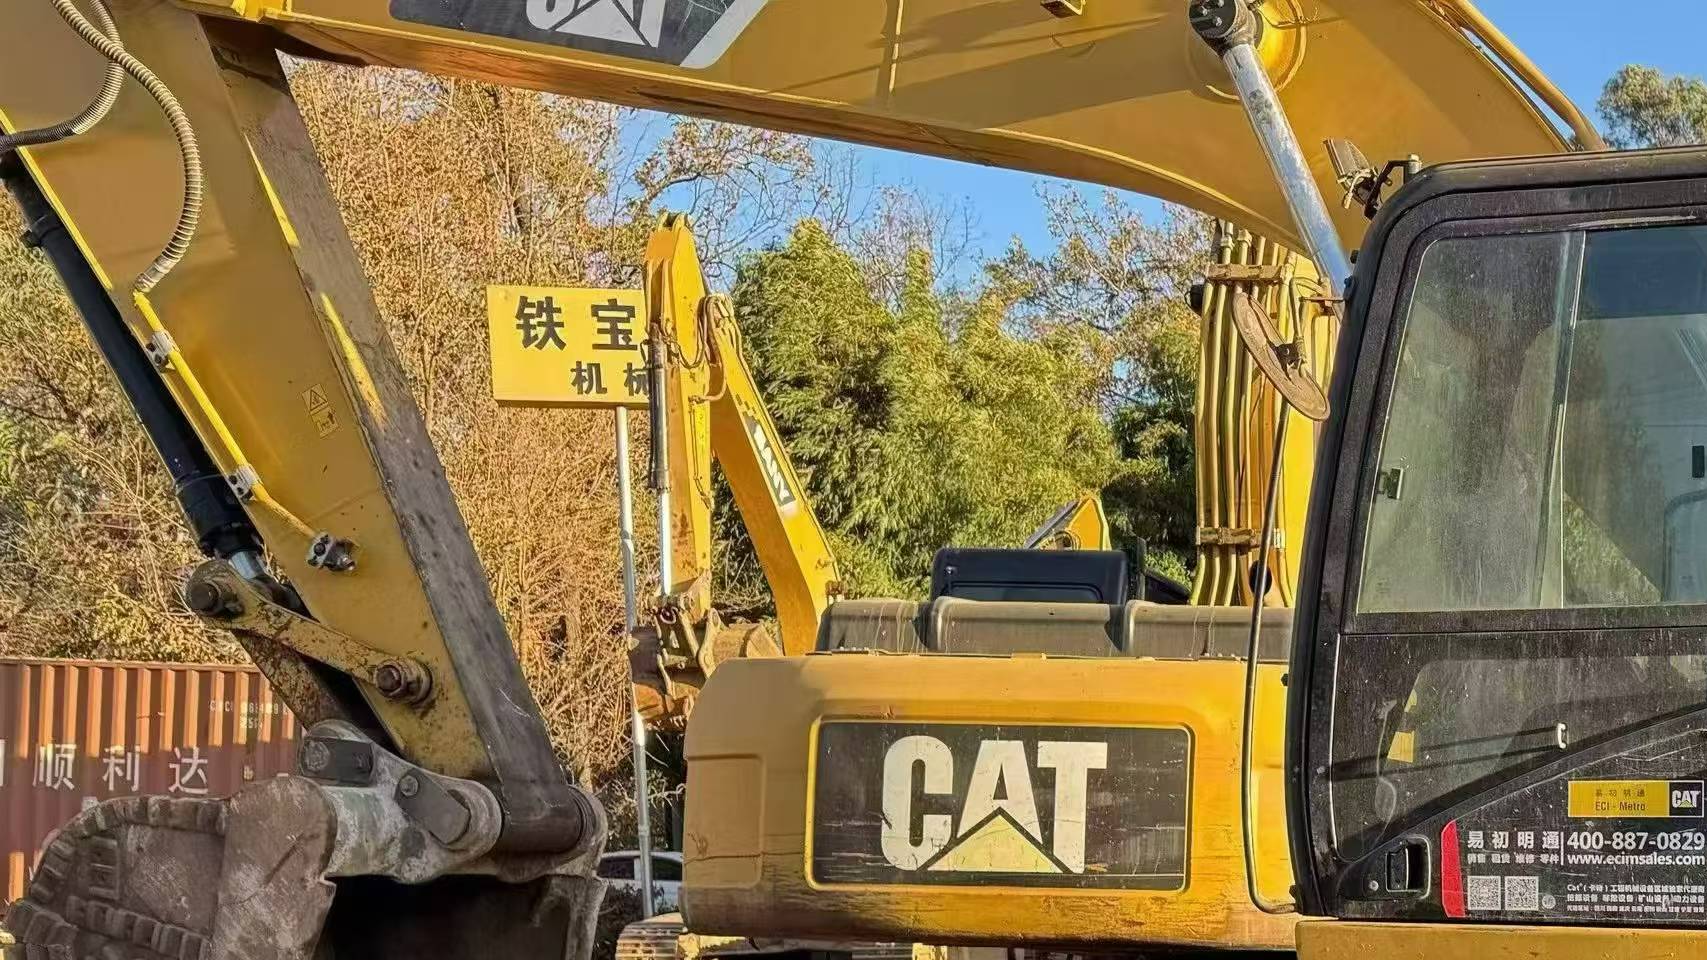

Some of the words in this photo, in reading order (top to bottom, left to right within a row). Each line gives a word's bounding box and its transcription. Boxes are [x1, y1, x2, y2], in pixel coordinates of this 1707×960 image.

[515, 295, 637, 351] 铁宝
[754, 424, 790, 502] SANY
[0, 738, 208, 795] 顺利达
[881, 735, 1108, 874] CAT
[1619, 801, 1646, 811] Metro
[1671, 790, 1701, 808] CAT
[1468, 830, 1559, 849] 易初明通
[1567, 831, 1706, 850] 400-887-0829
[1567, 851, 1706, 865] www.ecimsales.com
